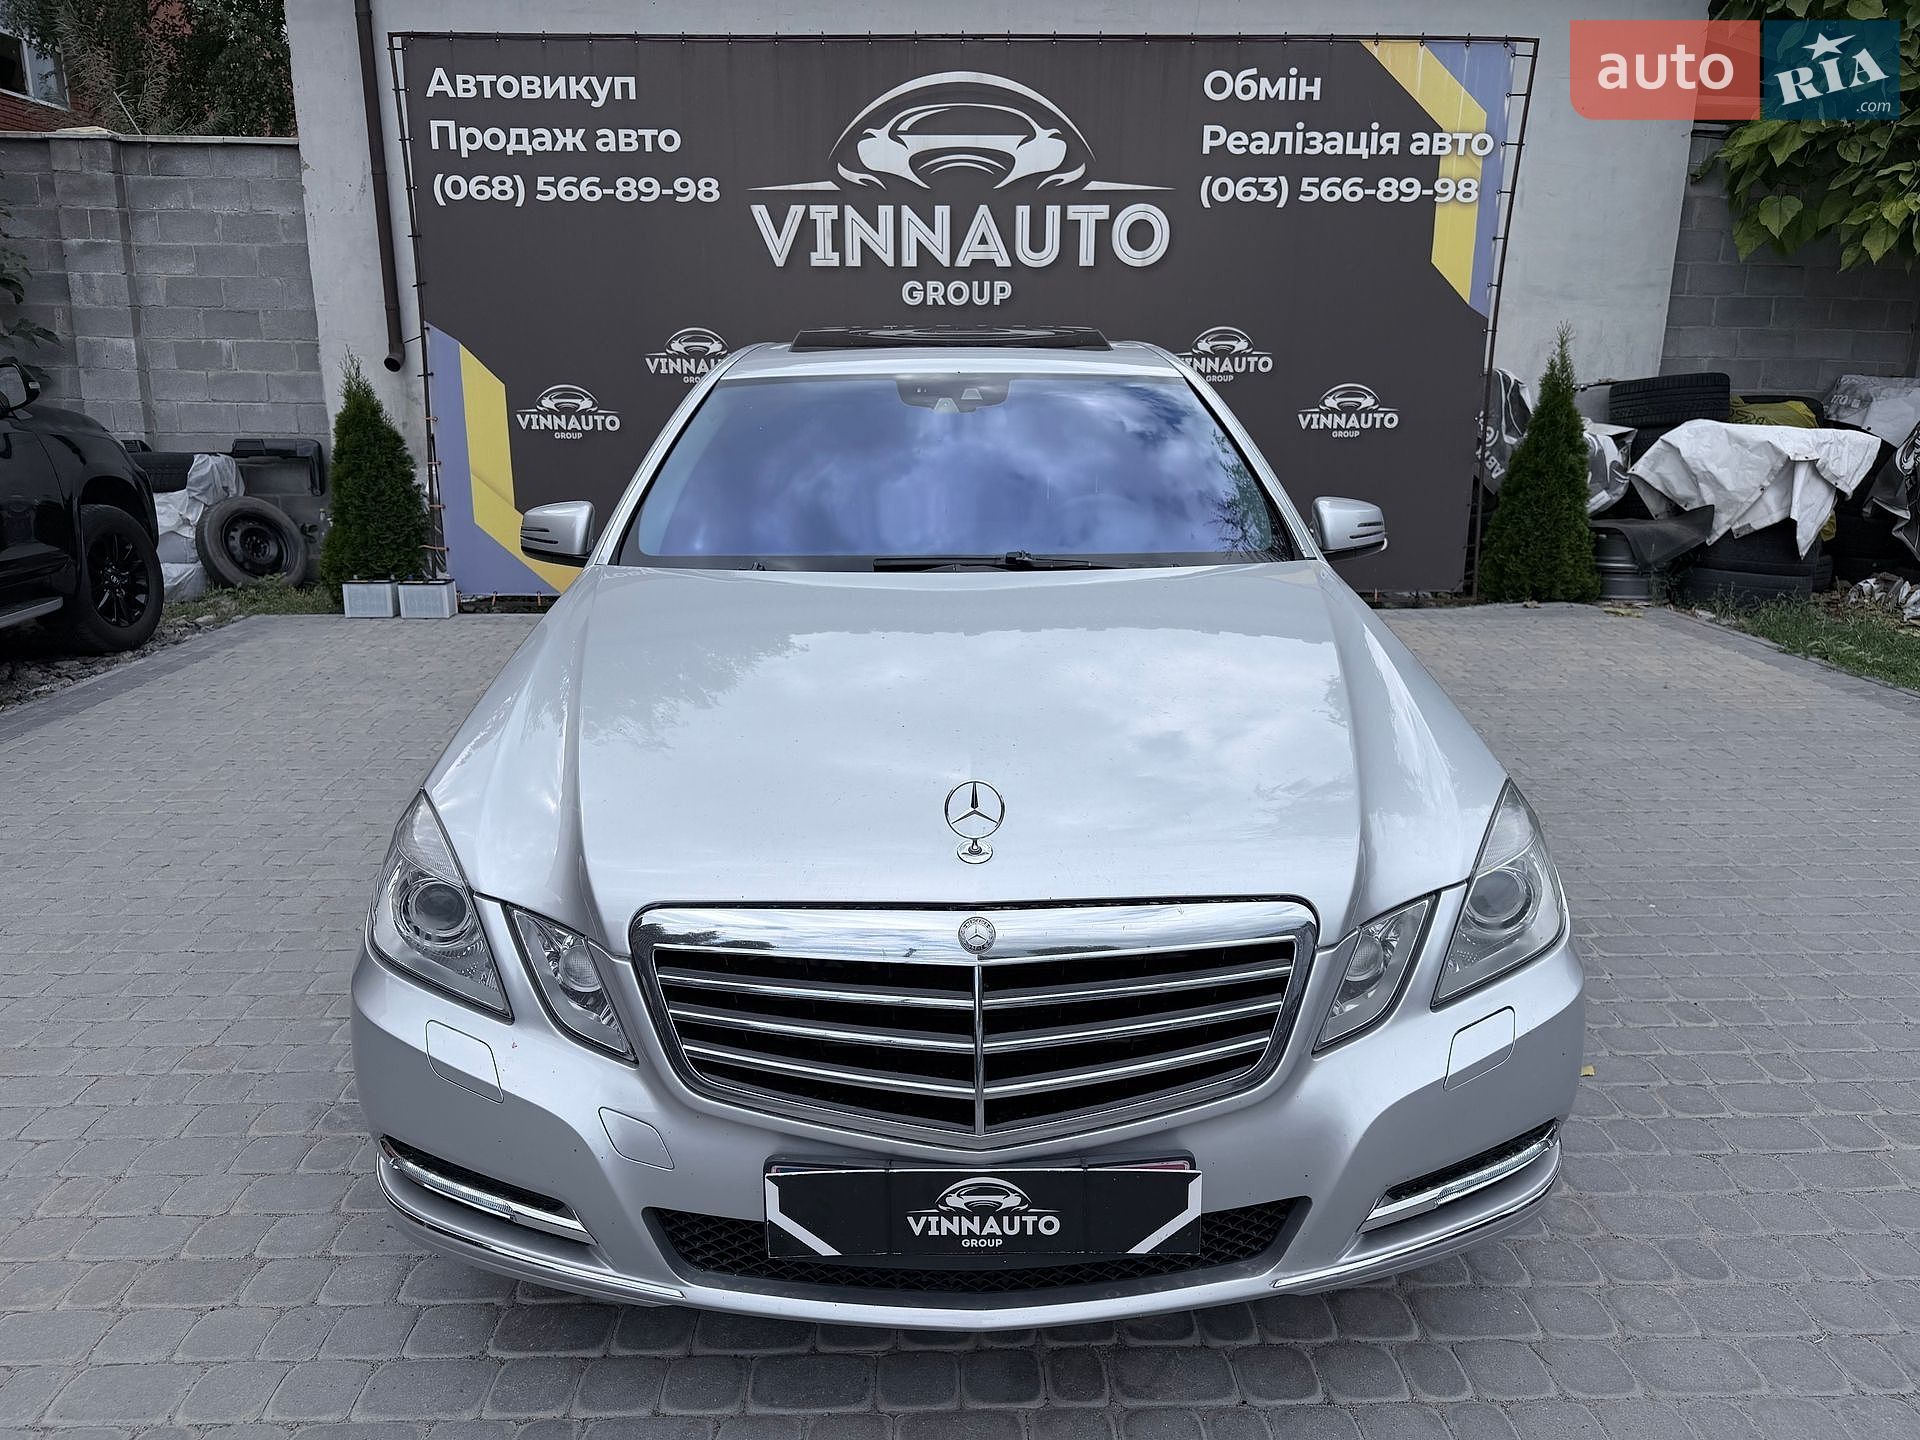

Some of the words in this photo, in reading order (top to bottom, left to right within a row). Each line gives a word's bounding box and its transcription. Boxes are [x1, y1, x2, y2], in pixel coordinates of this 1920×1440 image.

[426, 67, 637, 107] Автовикуп
[1203, 67, 1322, 101] Обмін
[429, 119, 587, 157] Продаж
[596, 129, 681, 153] авто
[1202, 122, 1400, 160] Реалізація
[1410, 131, 1495, 156] авто
[434, 173, 526, 207] (068)
[536, 176, 721, 203] 566-89-98
[1200, 176, 1289, 209] (063)
[1298, 176, 1479, 204] 566-89-98
[751, 204, 1170, 268] VINNAUTO
[902, 280, 1012, 306] GROUP
[1205, 374, 1234, 383] GROUP
[516, 413, 621, 432] VINNAUTO
[1297, 412, 1399, 430] VINNAUTO
[1331, 430, 1360, 438] GROUP
[554, 432, 583, 440] GROUP
[907, 1215, 1061, 1236] VINNAUTO
[961, 1238, 1003, 1248] GROUP
